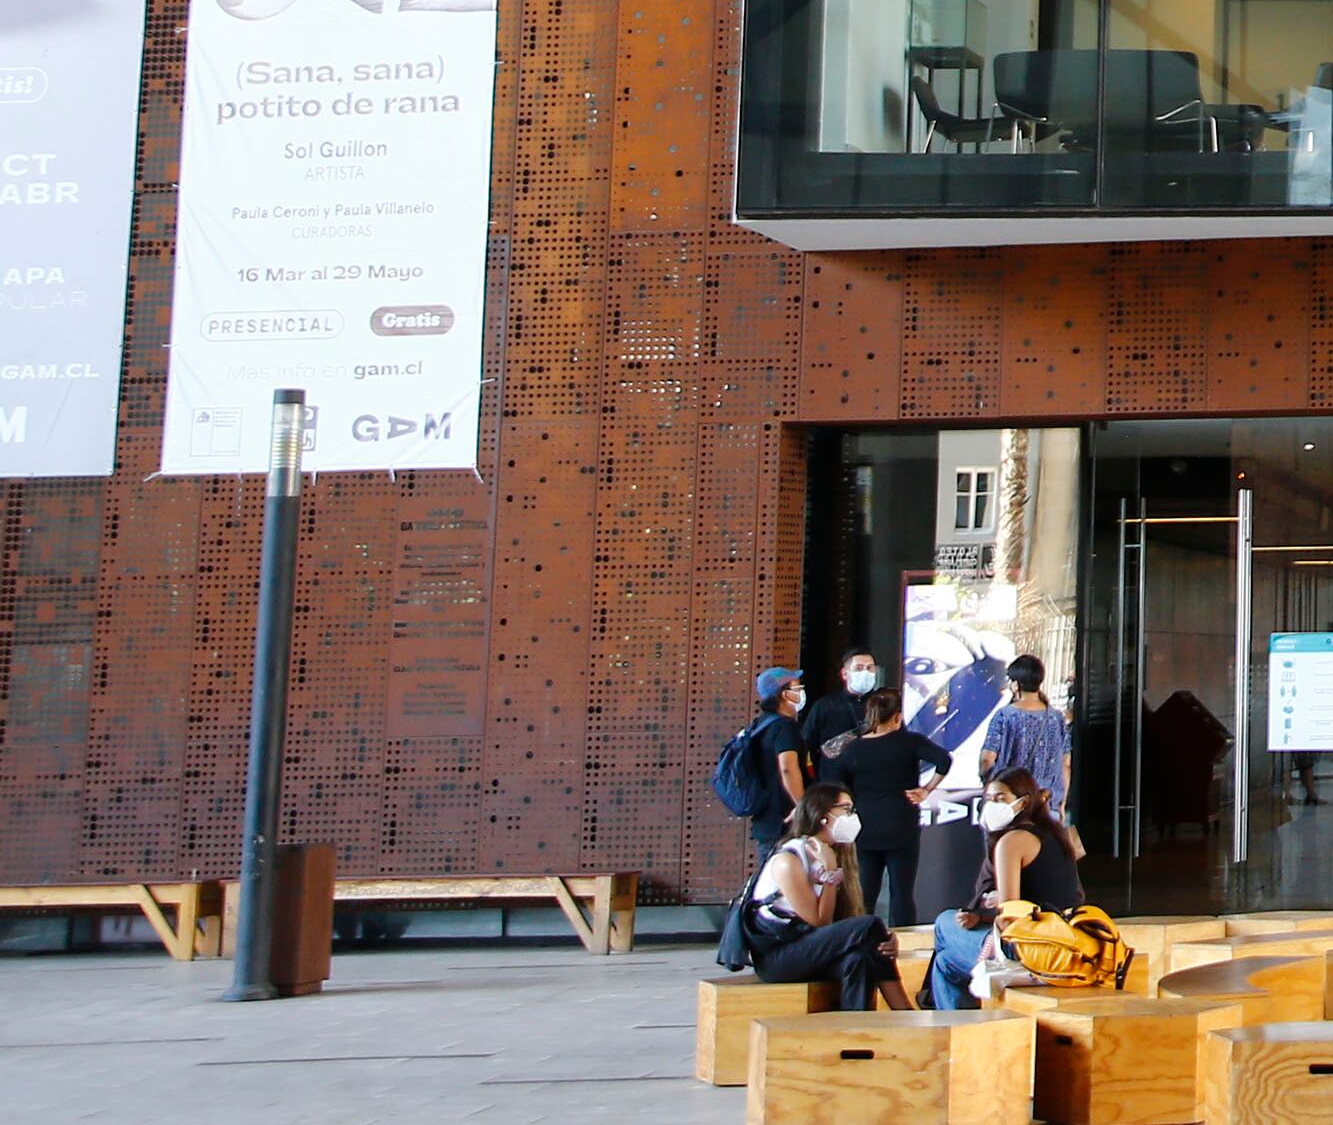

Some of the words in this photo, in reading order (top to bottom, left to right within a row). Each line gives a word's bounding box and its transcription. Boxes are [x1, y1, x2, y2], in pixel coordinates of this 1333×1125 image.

[236, 60, 343, 90] (Sana,
[352, 54, 445, 84] sana)
[216, 95, 322, 126] potito
[331, 92, 374, 117] de
[384, 94, 461, 115] rana
[284, 141, 313, 160] Sol
[319, 139, 388, 159] Guillon
[303, 165, 366, 182] ARTISTA
[0, 181, 80, 205] ABR
[232, 206, 269, 220] Paula
[272, 205, 320, 219] Ceroni
[323, 208, 331, 220] y
[335, 204, 372, 217] Paula
[290, 225, 373, 240] CURADORAS
[238, 268, 259, 283] 16
[266, 266, 308, 282] Mar
[311, 265, 329, 281] al
[333, 266, 362, 280] 29
[367, 264, 425, 281] Mayo
[207, 317, 335, 335] PRESENCIAL
[381, 312, 442, 329] Gratis
[2, 362, 101, 381] GAM.CL
[353, 359, 424, 380] gam.cl
[351, 411, 453, 443] GAM
